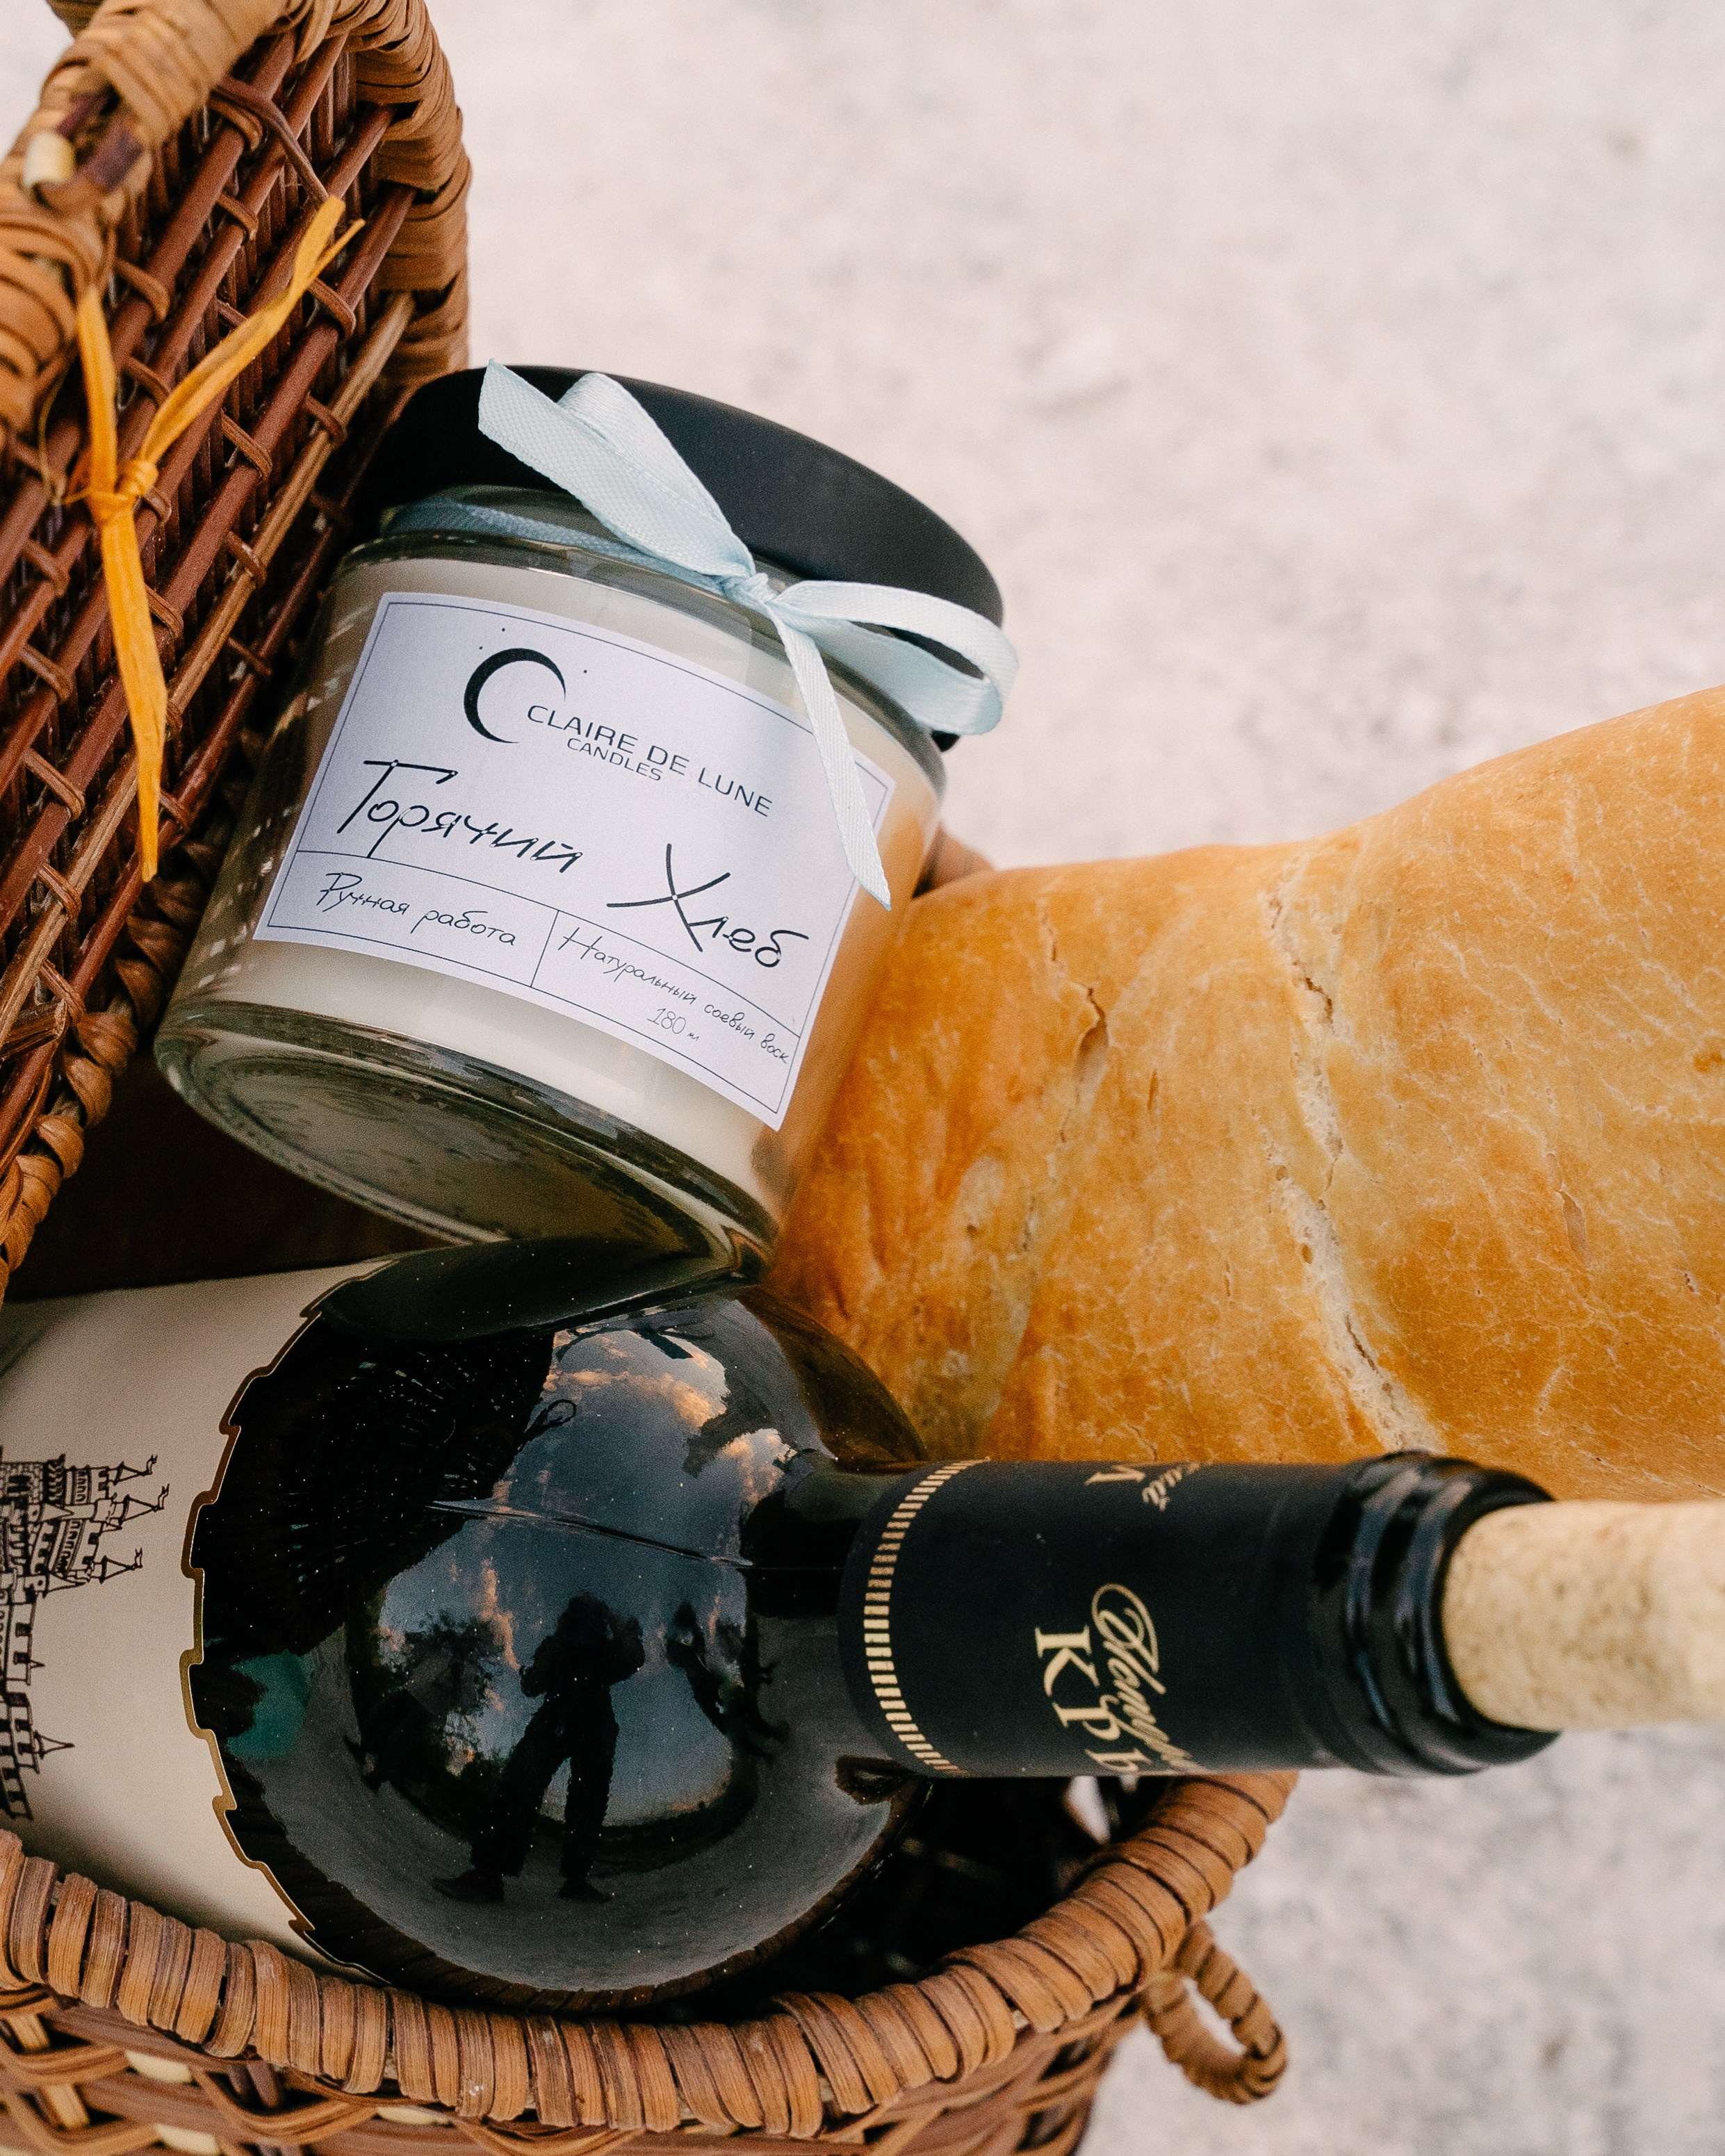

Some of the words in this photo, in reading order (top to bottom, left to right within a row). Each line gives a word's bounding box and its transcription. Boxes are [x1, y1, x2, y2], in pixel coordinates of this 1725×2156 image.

[528, 705, 638, 754] CLAIRE
[646, 745, 690, 776] DE
[698, 767, 773, 817] LUNE
[566, 737, 664, 781] CANDLES
[316, 872, 411, 915] Ручная
[410, 910, 516, 946] работа
[337, 759, 583, 873] Горячий
[606, 843, 810, 968] Хлеб
[557, 926, 697, 1005] Натуральный
[703, 1004, 755, 1040] соевый
[760, 1032, 790, 1064] воск
[646, 1008, 687, 1035] 180
[687, 1032, 700, 1043] мл
